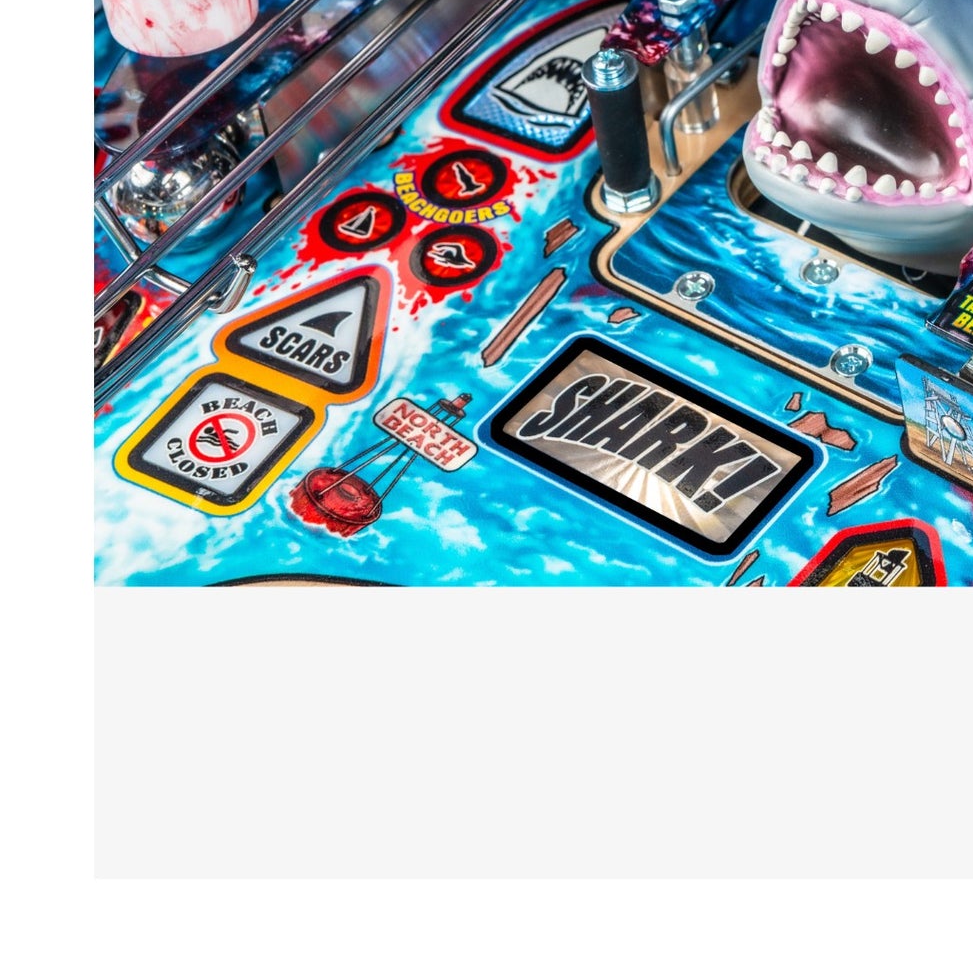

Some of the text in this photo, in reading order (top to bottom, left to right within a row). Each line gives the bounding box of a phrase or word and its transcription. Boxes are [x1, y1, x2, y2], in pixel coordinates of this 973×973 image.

[394, 171, 512, 225] BEACHGOERS
[259, 325, 351, 375] SCARS
[201, 397, 279, 437] BEACH
[382, 414, 455, 466] BEACH
[393, 402, 471, 457] NORTH
[166, 437, 249, 480] CLOSED
[516, 373, 782, 514] SHARK!
